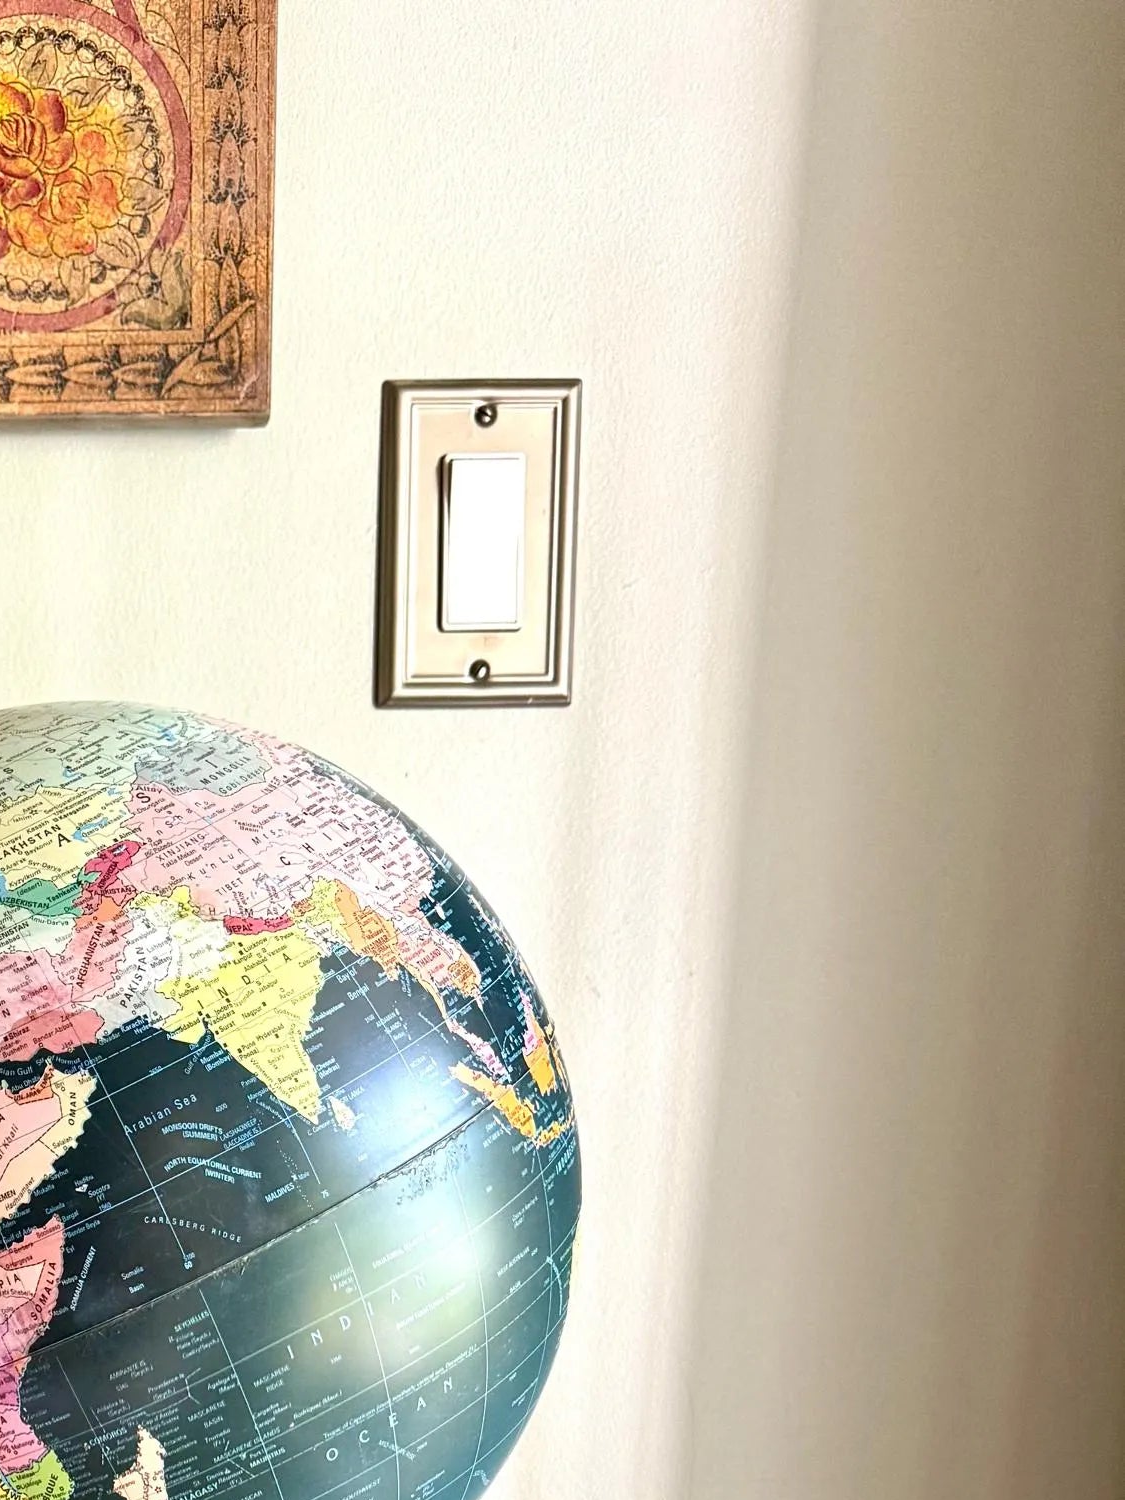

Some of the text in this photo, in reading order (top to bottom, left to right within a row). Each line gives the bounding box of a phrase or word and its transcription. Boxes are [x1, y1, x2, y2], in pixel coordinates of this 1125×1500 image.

[199, 757, 252, 786] MONGOLIA
[219, 781, 240, 796] Gobi
[215, 878, 244, 896] TIBET
[100, 936, 120, 949] Kabul
[243, 937, 268, 953] Lucknow
[76, 923, 105, 989] AFGHANISTAN
[119, 946, 146, 1008] PAKISTAN
[197, 952, 292, 1009] INDIA
[242, 1005, 262, 1019] Nagpur
[9, 1026, 31, 1040] Shiraz
[120, 1019, 145, 1033] Karachi
[219, 1019, 236, 1032] Surat
[256, 1023, 285, 1042] Hyderabad
[16, 1066, 34, 1076] Gulf
[68, 1091, 77, 1126] OMAN
[124, 1092, 198, 1135] Arabian Sea
[2, 1123, 20, 1150] Khali
[161, 1122, 223, 1135] MONSOON DRIFTS
[182, 1131, 218, 1141] (SUMMER)
[164, 1156, 262, 1179] NORTH EQUATORIAL CURRENT
[204, 1169, 235, 1184] (WINTER)
[88, 1183, 111, 1198] Socotra
[264, 1182, 295, 1203] MALDIVES
[211, 1227, 242, 1243] RIDGE
[69, 1246, 97, 1311] SOMALIA CURRENT
[121, 1265, 145, 1294] Somalia Basin
[30, 1261, 57, 1321] SOMALIA
[285, 1272, 426, 1361] INDIAN
[325, 1377, 455, 1462] OCEAN
[88, 1428, 128, 1447] COMOROS
